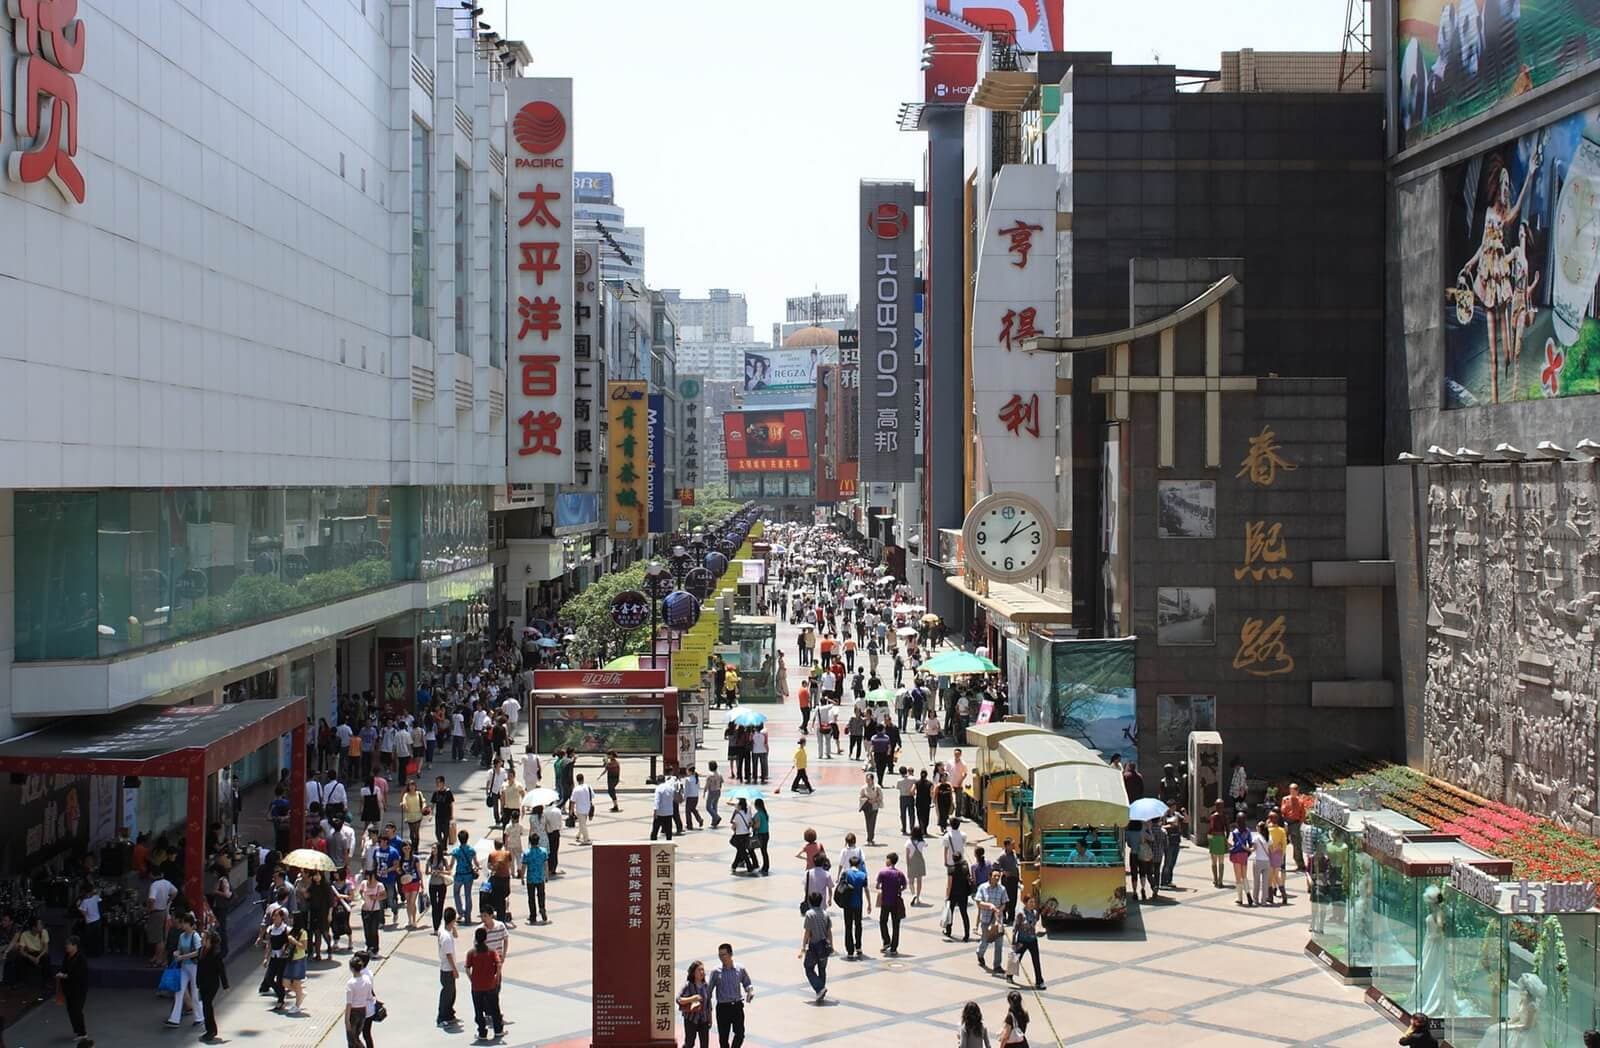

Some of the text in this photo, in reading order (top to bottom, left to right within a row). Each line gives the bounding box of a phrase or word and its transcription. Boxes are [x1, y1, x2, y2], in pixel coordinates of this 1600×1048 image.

[515, 158, 564, 168] PACIFIC
[518, 184, 561, 456] 太平洋百货
[998, 219, 1044, 438] 亨得利
[774, 369, 806, 378] REGZA
[874, 408, 898, 452] 高邦
[977, 532, 986, 545] 9
[1031, 531, 1040, 544] 3
[1004, 557, 1013, 570] 6
[581, 672, 624, 686] 可口可乐
[628, 853, 642, 928] 春熙路示范街
